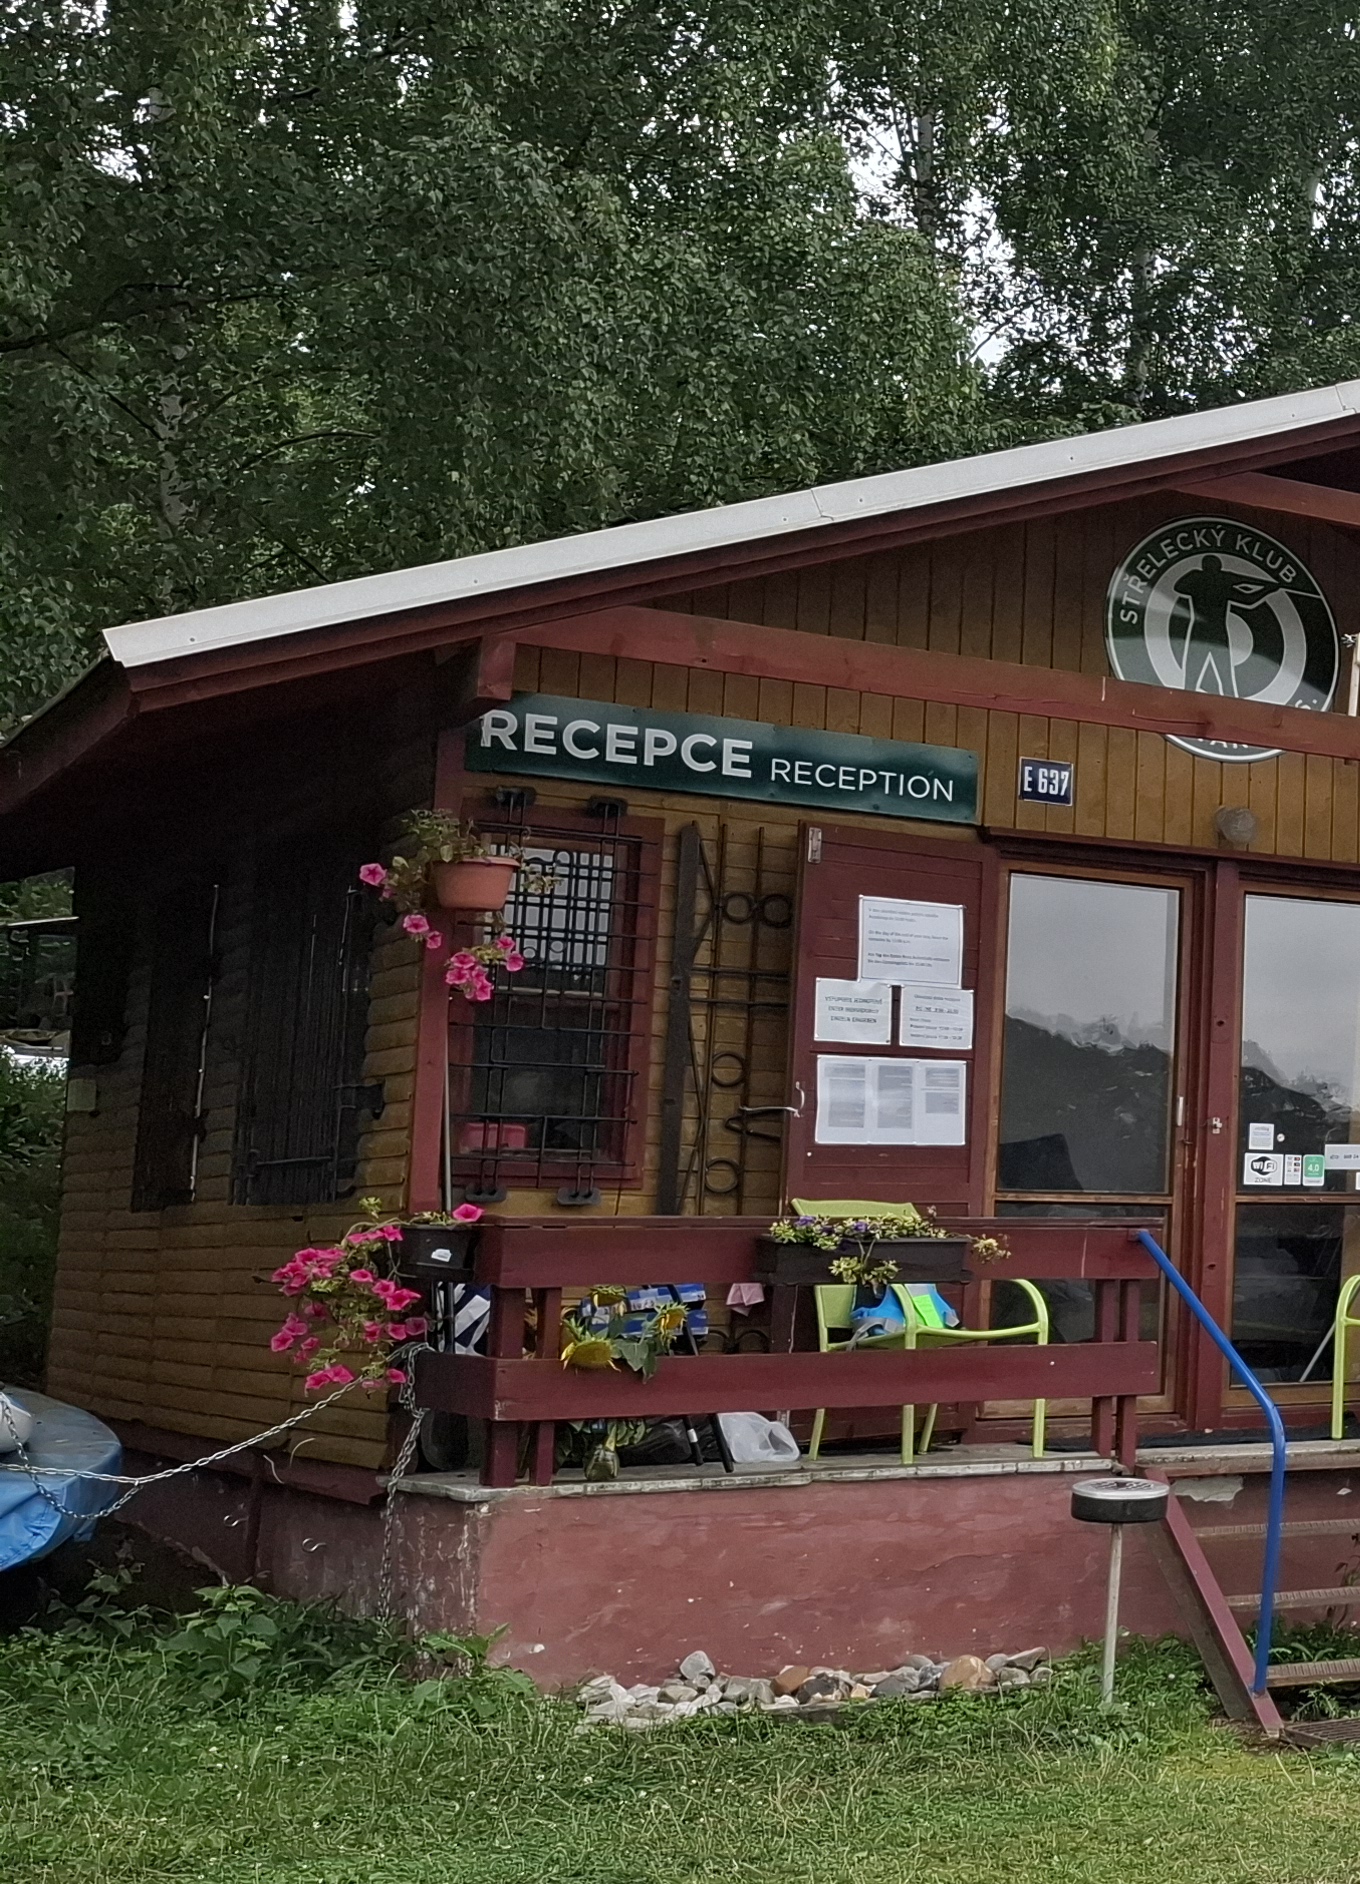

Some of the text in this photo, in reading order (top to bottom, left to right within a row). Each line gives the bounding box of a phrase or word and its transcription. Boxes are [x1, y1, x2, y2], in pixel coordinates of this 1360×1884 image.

[1120, 525, 1297, 624] STŘELECKÝ KLUB
[480, 709, 954, 802] RECEPCE RECEPTION
[1023, 766, 1070, 796] E 637
